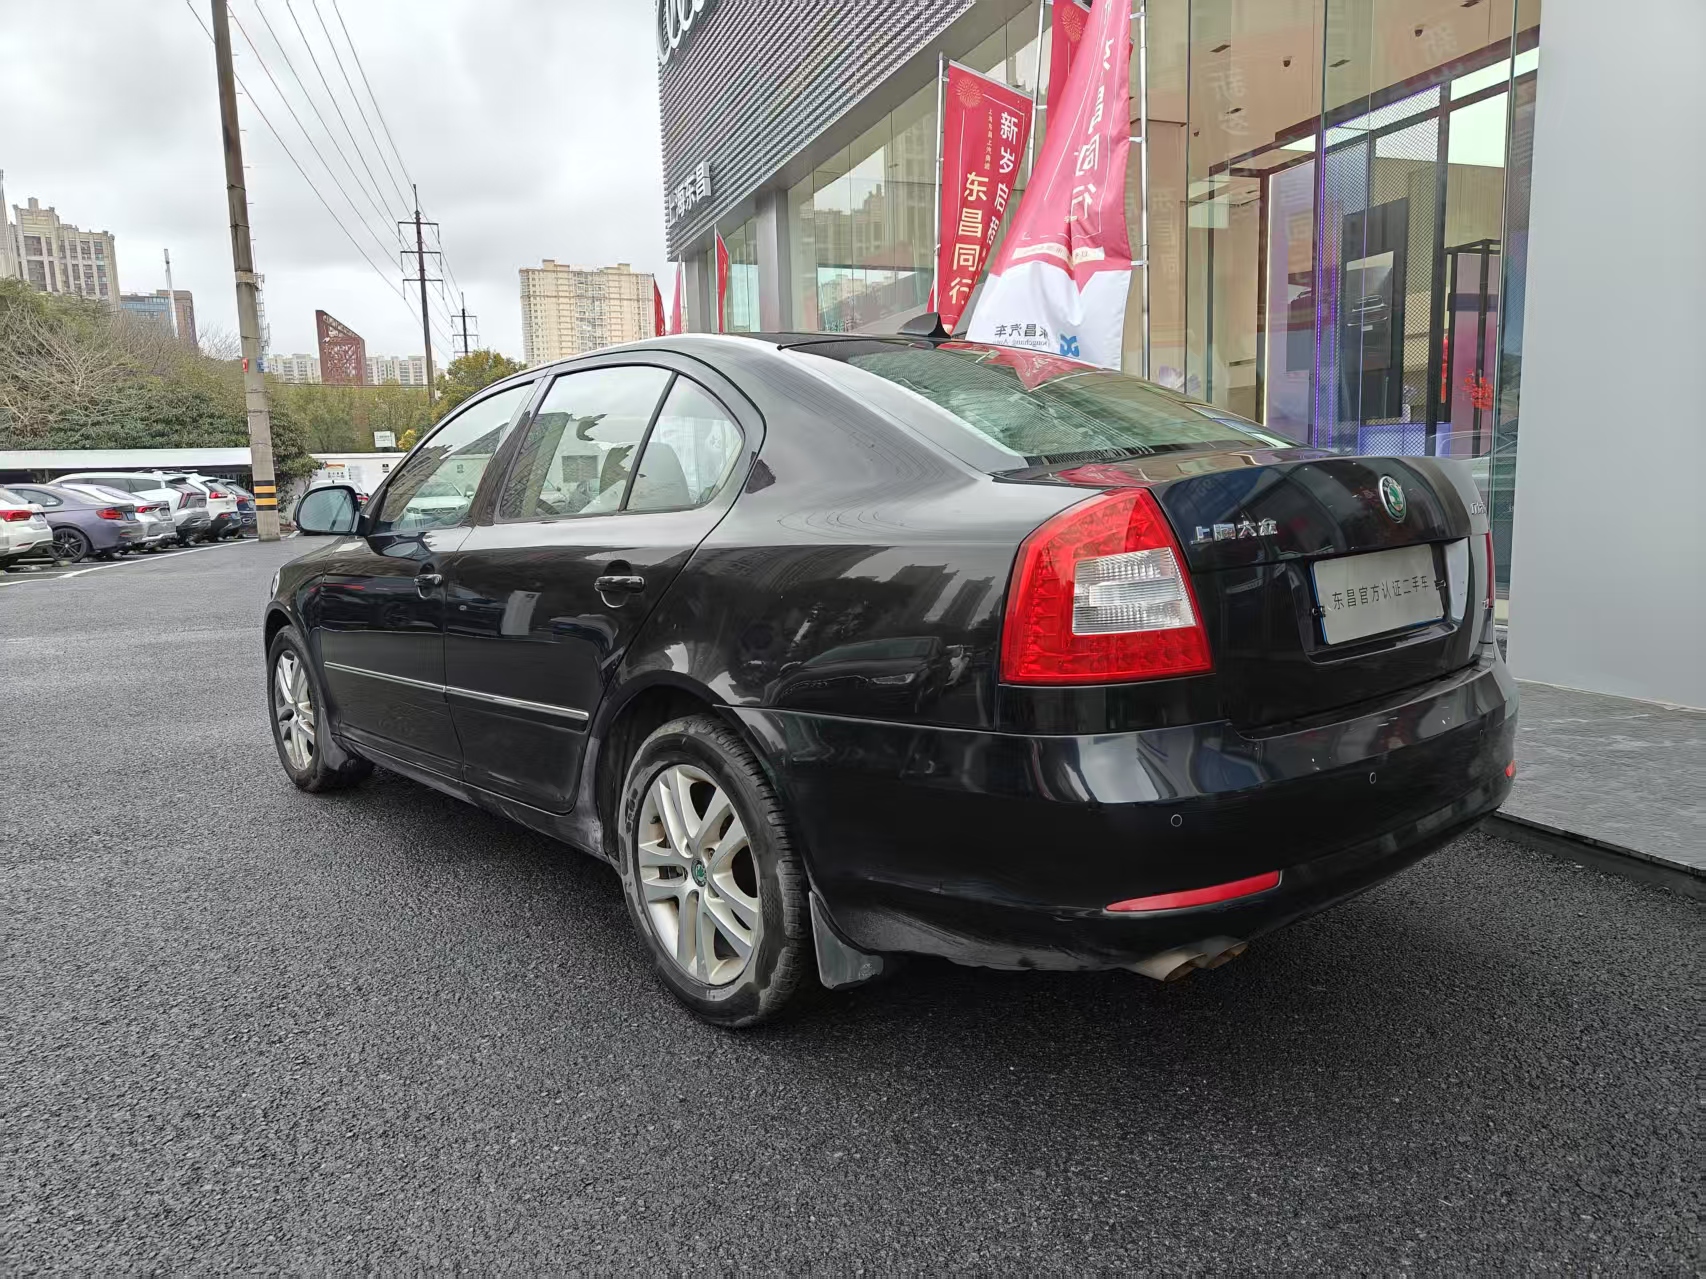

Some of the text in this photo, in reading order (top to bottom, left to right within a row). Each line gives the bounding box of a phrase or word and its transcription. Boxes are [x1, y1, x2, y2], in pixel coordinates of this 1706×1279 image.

[949, 171, 989, 305] 东昌同行
[1190, 518, 1278, 545] 上海大众
[1332, 575, 1429, 610] 东昌官方认证二手车
